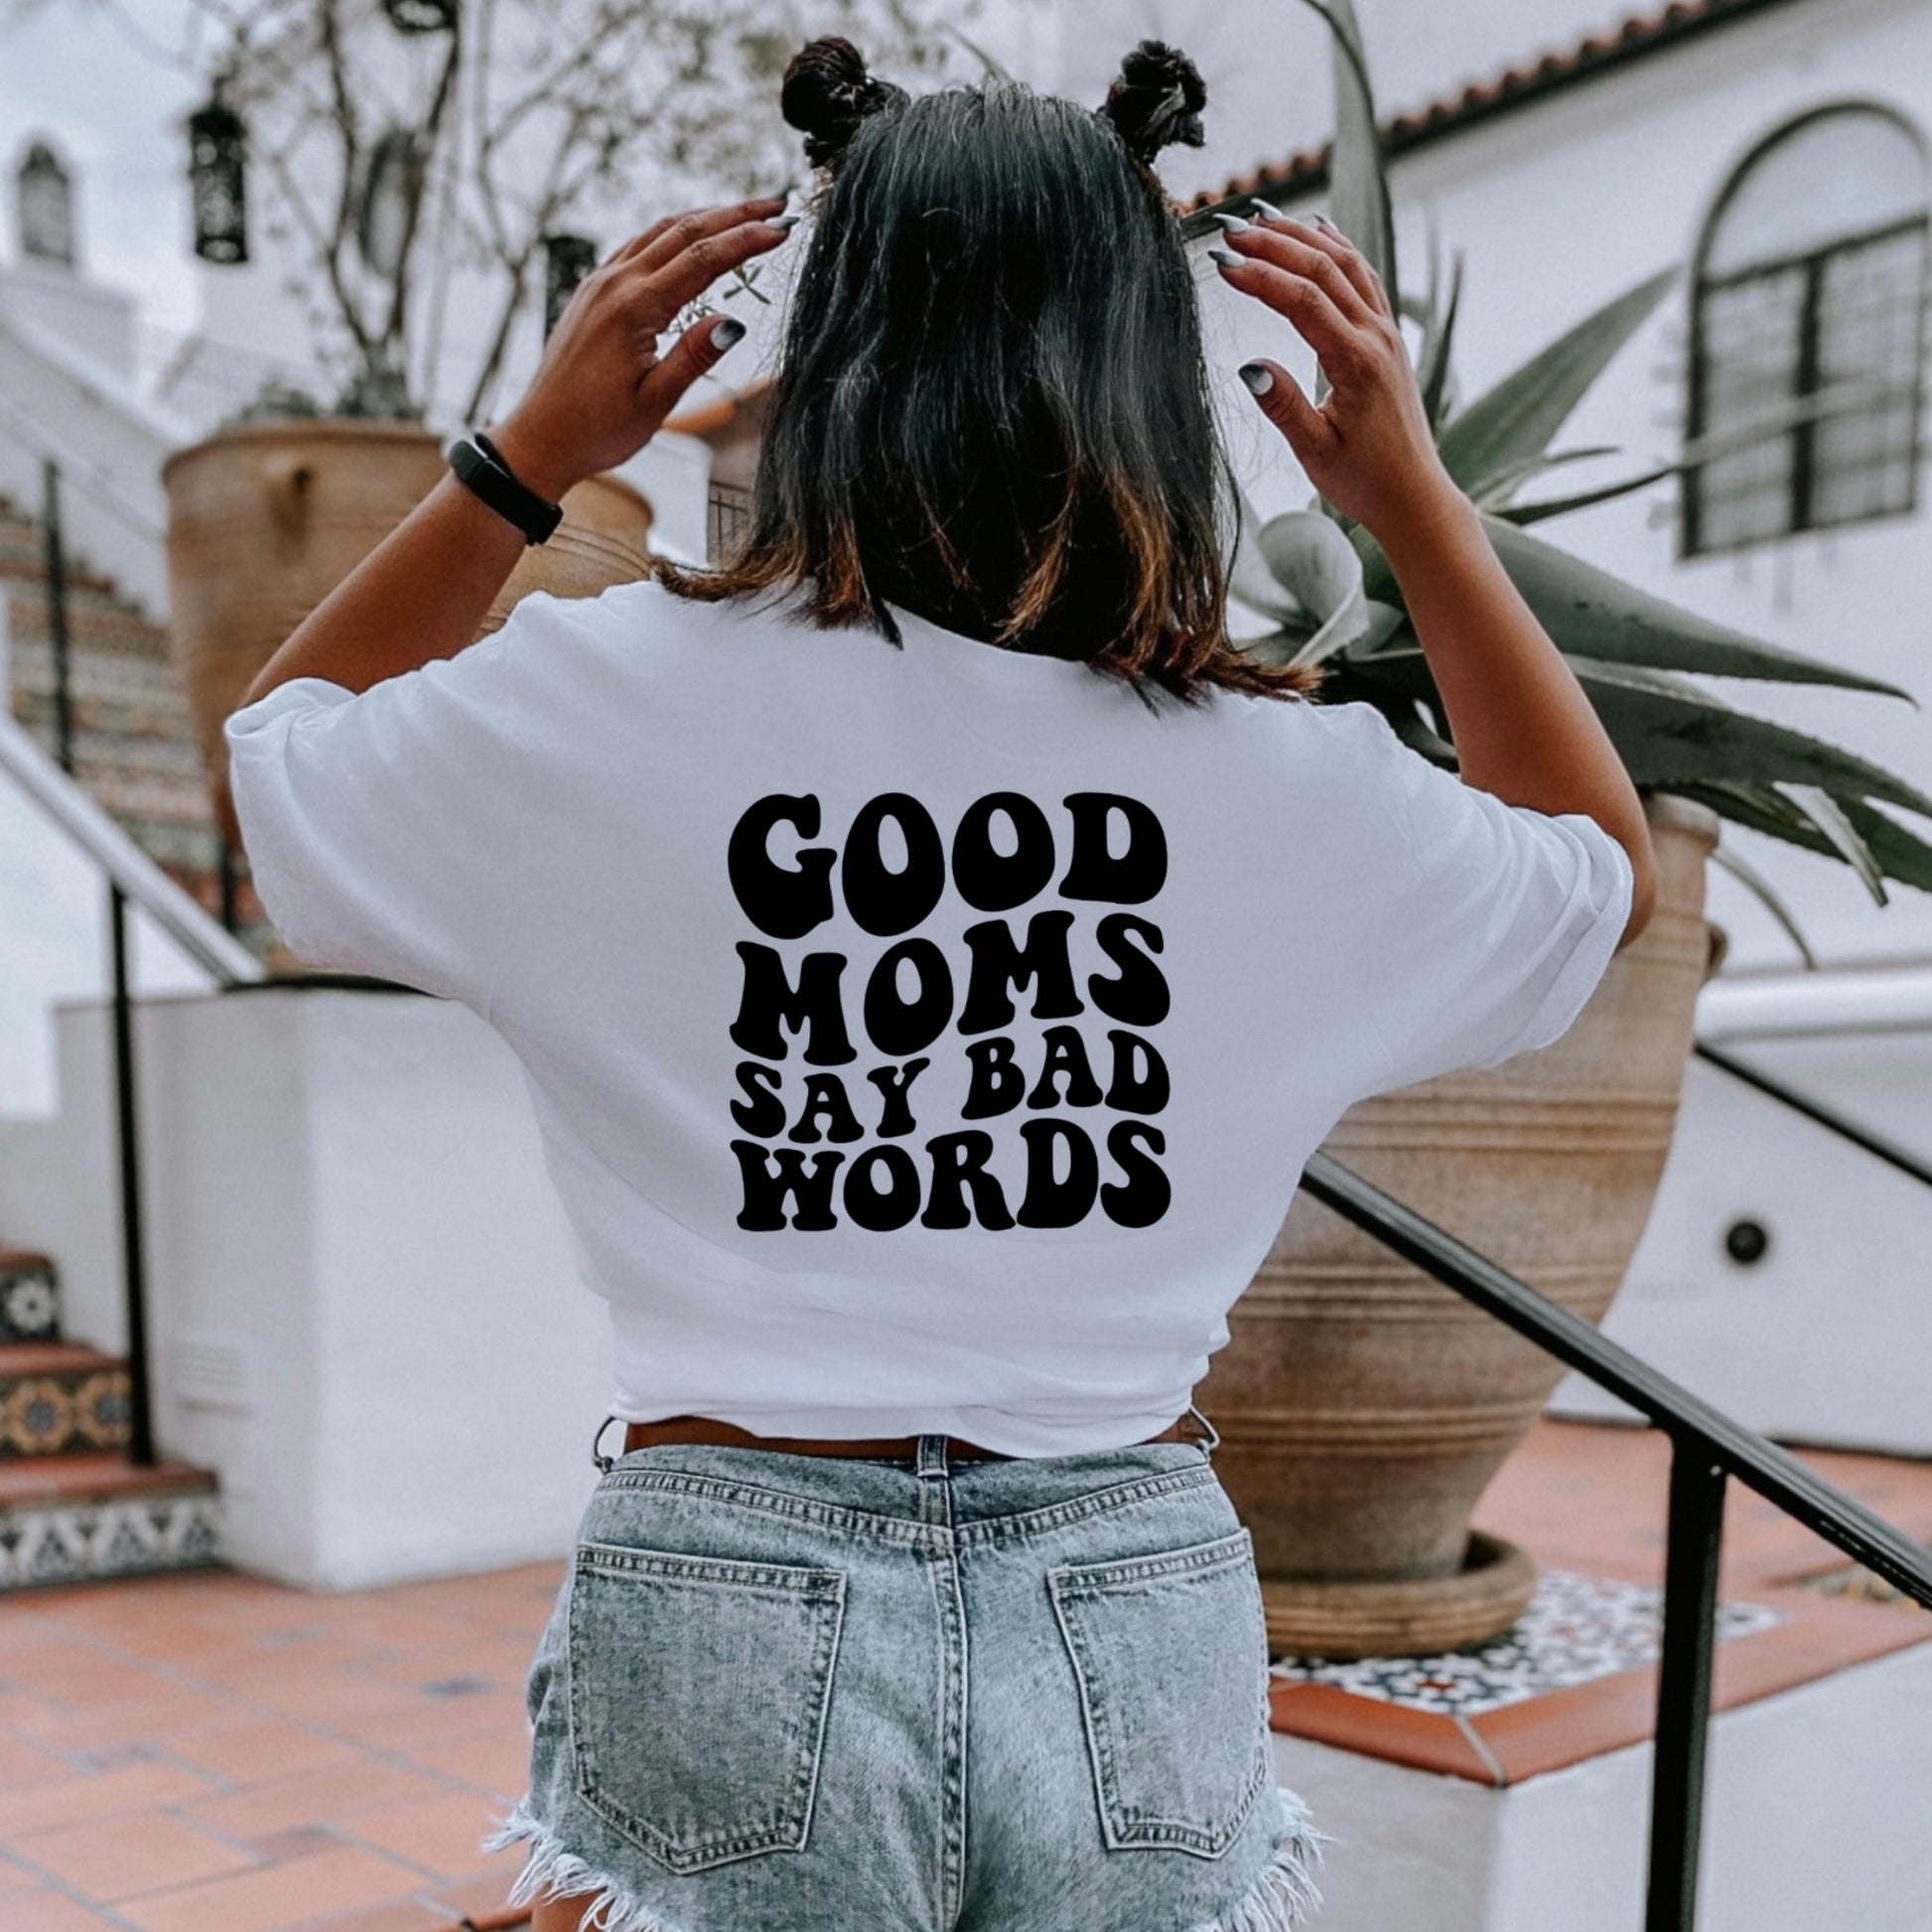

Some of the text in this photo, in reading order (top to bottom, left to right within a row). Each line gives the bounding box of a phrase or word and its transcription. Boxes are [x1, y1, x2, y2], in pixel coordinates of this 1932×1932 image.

[728, 791, 1168, 939] GOOD
[730, 910, 1171, 1066] MOMS
[730, 1026, 1171, 1144] SAY BAD
[730, 1118, 1172, 1232] WORDS
